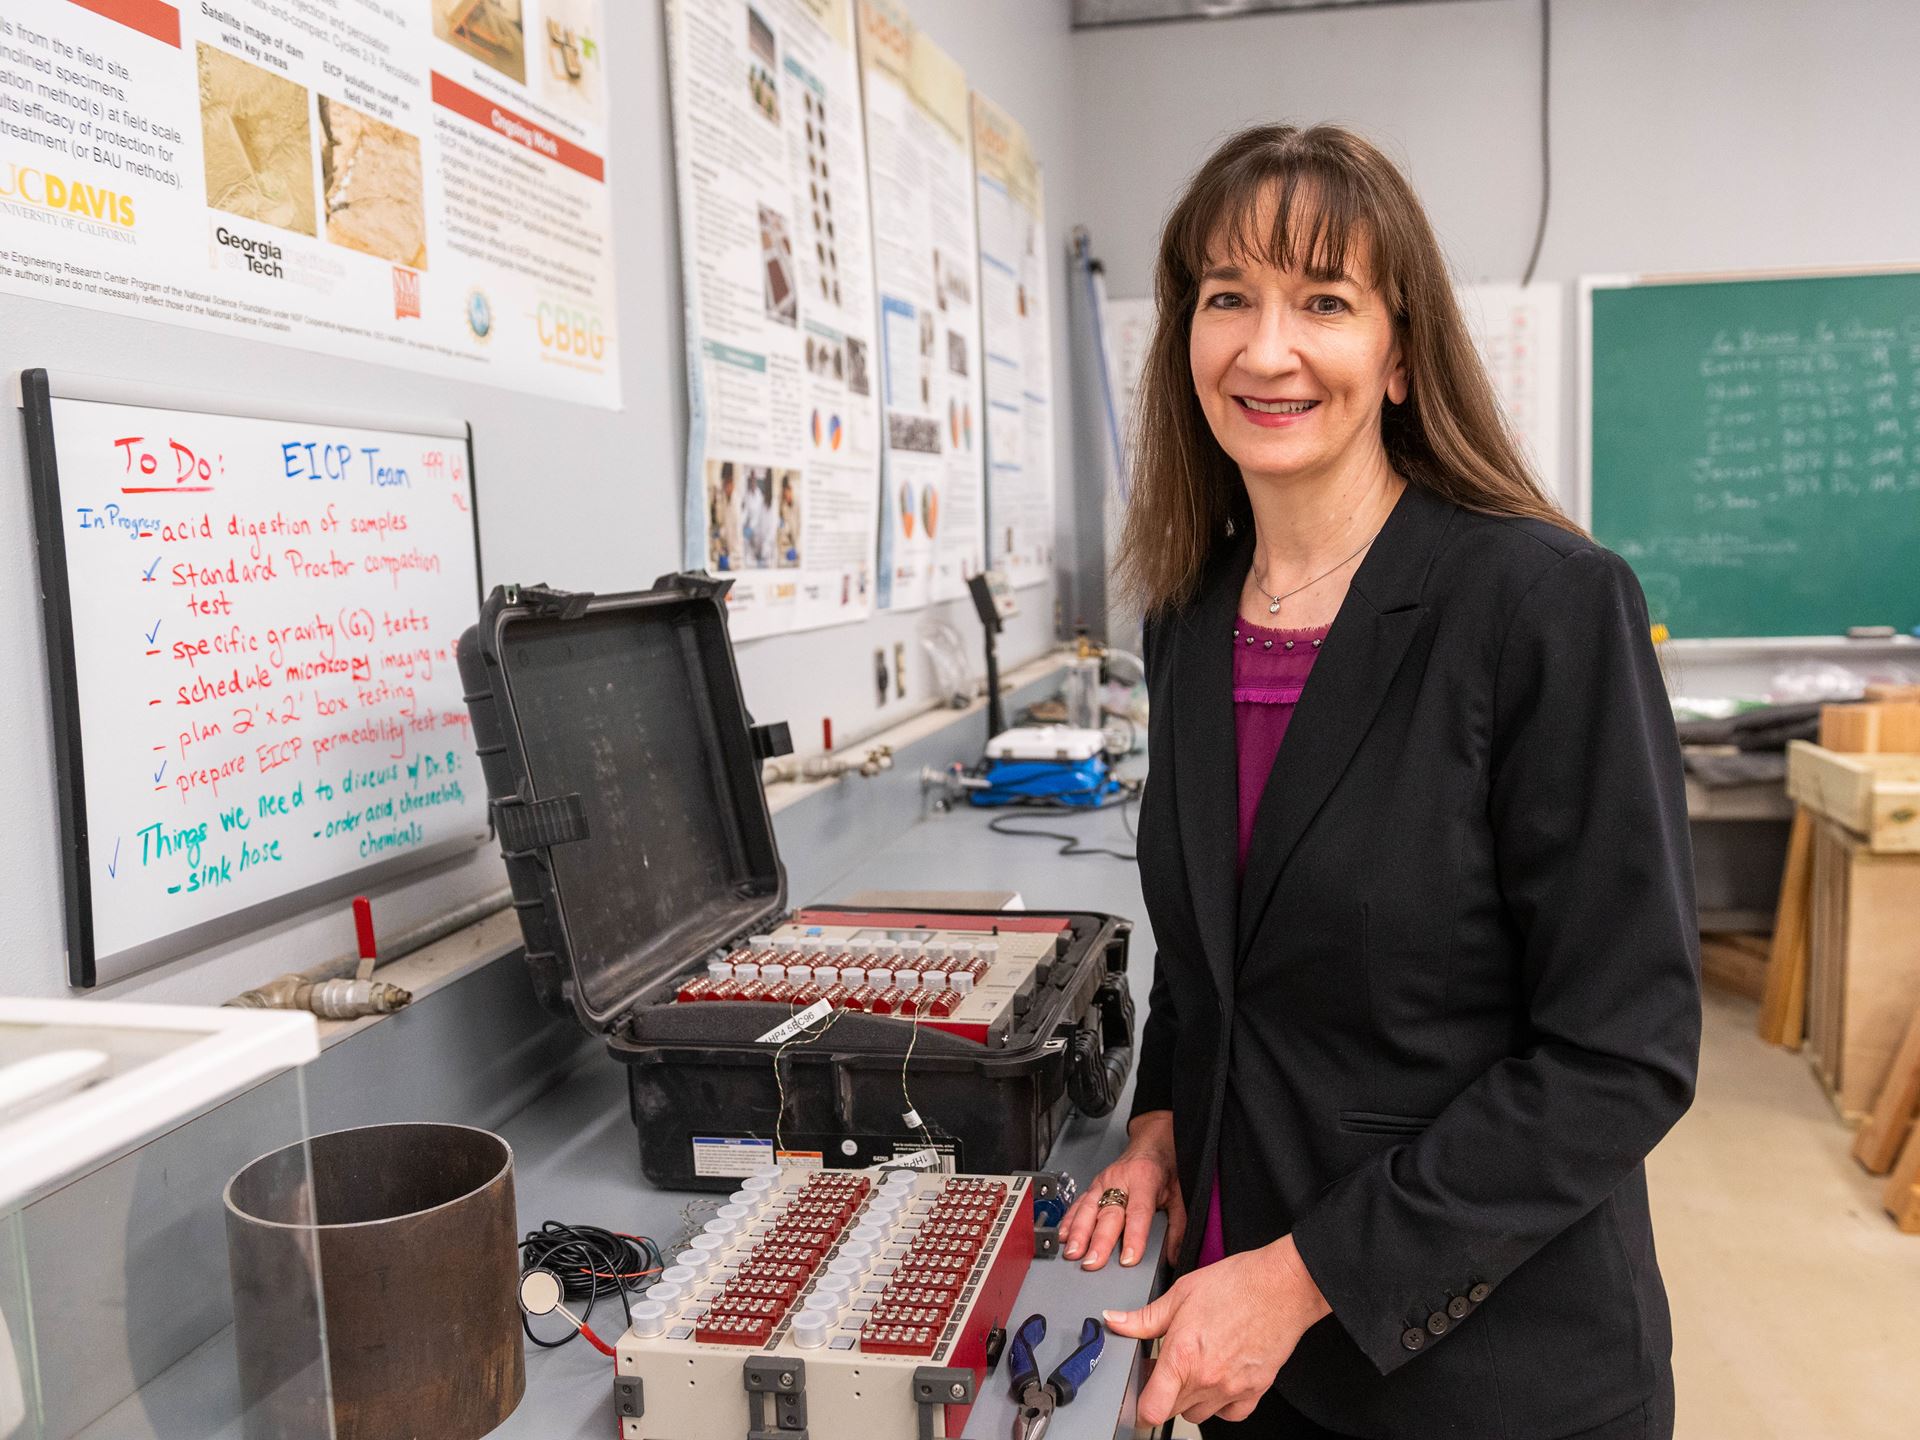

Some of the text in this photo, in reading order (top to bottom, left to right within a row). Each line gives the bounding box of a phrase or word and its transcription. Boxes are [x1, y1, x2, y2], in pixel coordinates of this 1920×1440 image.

[17, 23, 49, 49] from
[52, 39, 74, 59] the
[77, 46, 104, 70] field
[107, 61, 133, 82] site.
[200, 2, 304, 60] Satellite image of dam
[221, 32, 288, 71] with key areas
[56, 65, 128, 103] specimens.
[38, 81, 105, 120] method(s)
[108, 108, 121, 123] at
[123, 110, 149, 132] field
[151, 124, 185, 145] scale.
[0, 120, 183, 190] treatment (or BAU methods).
[79, 121, 92, 136] of
[95, 126, 157, 157] protection
[158, 144, 174, 163] for
[0, 201, 138, 246] NIVERSITY OF CALIFORNIA
[216, 227, 282, 260] Georgia
[11, 251, 62, 273] Engineering
[64, 262, 101, 280] Research
[104, 271, 129, 285] Center
[131, 277, 161, 293] Program
[163, 285, 171, 294] of
[171, 286, 183, 297] the
[184, 289, 211, 303] National
[243, 253, 284, 280] Tech
[14, 269, 53, 287] author(s)
[55, 277, 70, 288] and
[72, 280, 82, 290] do
[85, 283, 97, 293] not
[99, 286, 140, 304] necessarily
[142, 294, 163, 307] reflect
[165, 299, 184, 311] those
[185, 304, 193, 313] of
[194, 305, 205, 316] the
[536, 301, 607, 360] CBBG
[114, 437, 224, 483] To Do:
[281, 442, 351, 481] EICP
[77, 503, 160, 540] In Progress
[227, 513, 311, 560] digestion
[320, 503, 340, 532] of
[351, 512, 408, 542] samples
[284, 549, 355, 579] Proctor
[364, 547, 441, 591] compaction
[187, 591, 233, 617] test
[172, 625, 258, 668] specific
[267, 613, 335, 669] gravity
[383, 608, 430, 637] tests
[177, 664, 272, 705] schedule
[381, 648, 433, 681] imaging
[179, 721, 222, 761] plan
[314, 688, 349, 716] box
[358, 679, 417, 719] testing
[176, 755, 246, 805] prepare
[256, 737, 303, 774] EICP
[312, 716, 407, 766] permeability
[408, 707, 438, 733] test
[137, 822, 208, 870] Things
[220, 806, 252, 832] we
[259, 780, 305, 819] need
[315, 779, 334, 801] to
[359, 820, 425, 859] chemicals
[240, 841, 283, 872] hose
